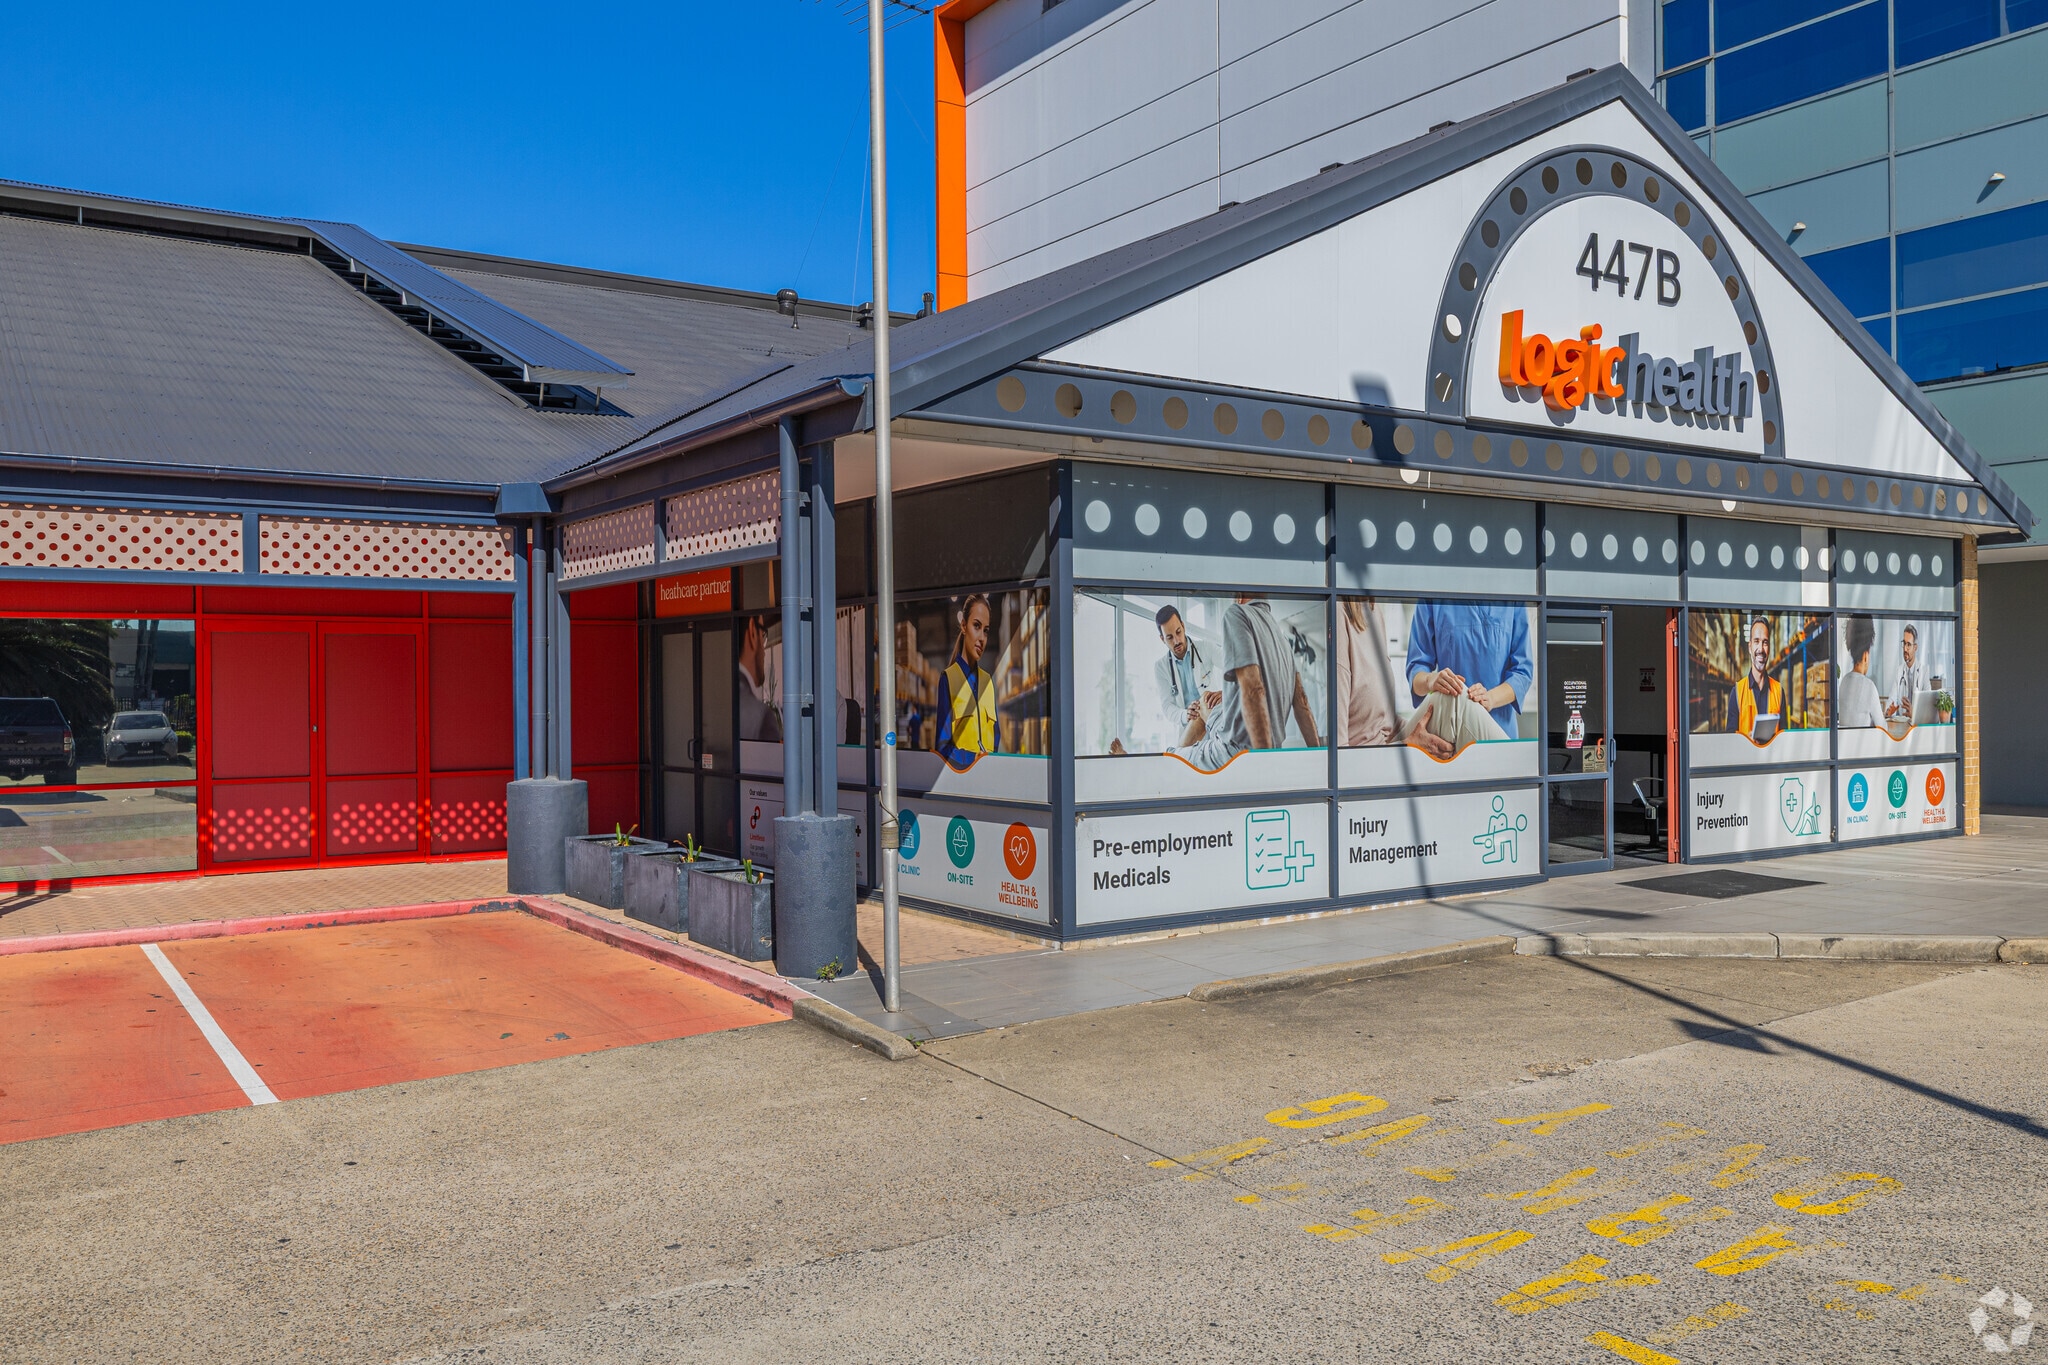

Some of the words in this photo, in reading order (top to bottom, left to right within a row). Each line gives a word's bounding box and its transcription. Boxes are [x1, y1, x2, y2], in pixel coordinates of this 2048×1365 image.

[1575, 232, 1682, 307] 447B
[660, 581, 699, 600] heathcare
[700, 580, 731, 601] partner
[1697, 791, 1725, 809] Injury
[1847, 816, 1853, 824] IN
[1853, 815, 1869, 823] CLINIC
[1888, 811, 1907, 820] ON-SITE
[1922, 816, 1947, 824] WELLBEING
[1923, 808, 1941, 816] HEALTH
[1941, 807, 1945, 815] &
[1349, 816, 1389, 837] Injury
[1697, 812, 1749, 831] Prevention
[1092, 829, 1234, 859] Pre-employment
[1349, 839, 1438, 865] Management
[900, 863, 921, 876] CLINIC
[947, 872, 974, 886] ON-SITE
[1093, 866, 1171, 892] Medicals
[1001, 881, 1030, 896] HEALTH
[1031, 886, 1037, 897] &
[998, 892, 1039, 910] WELLBEING
